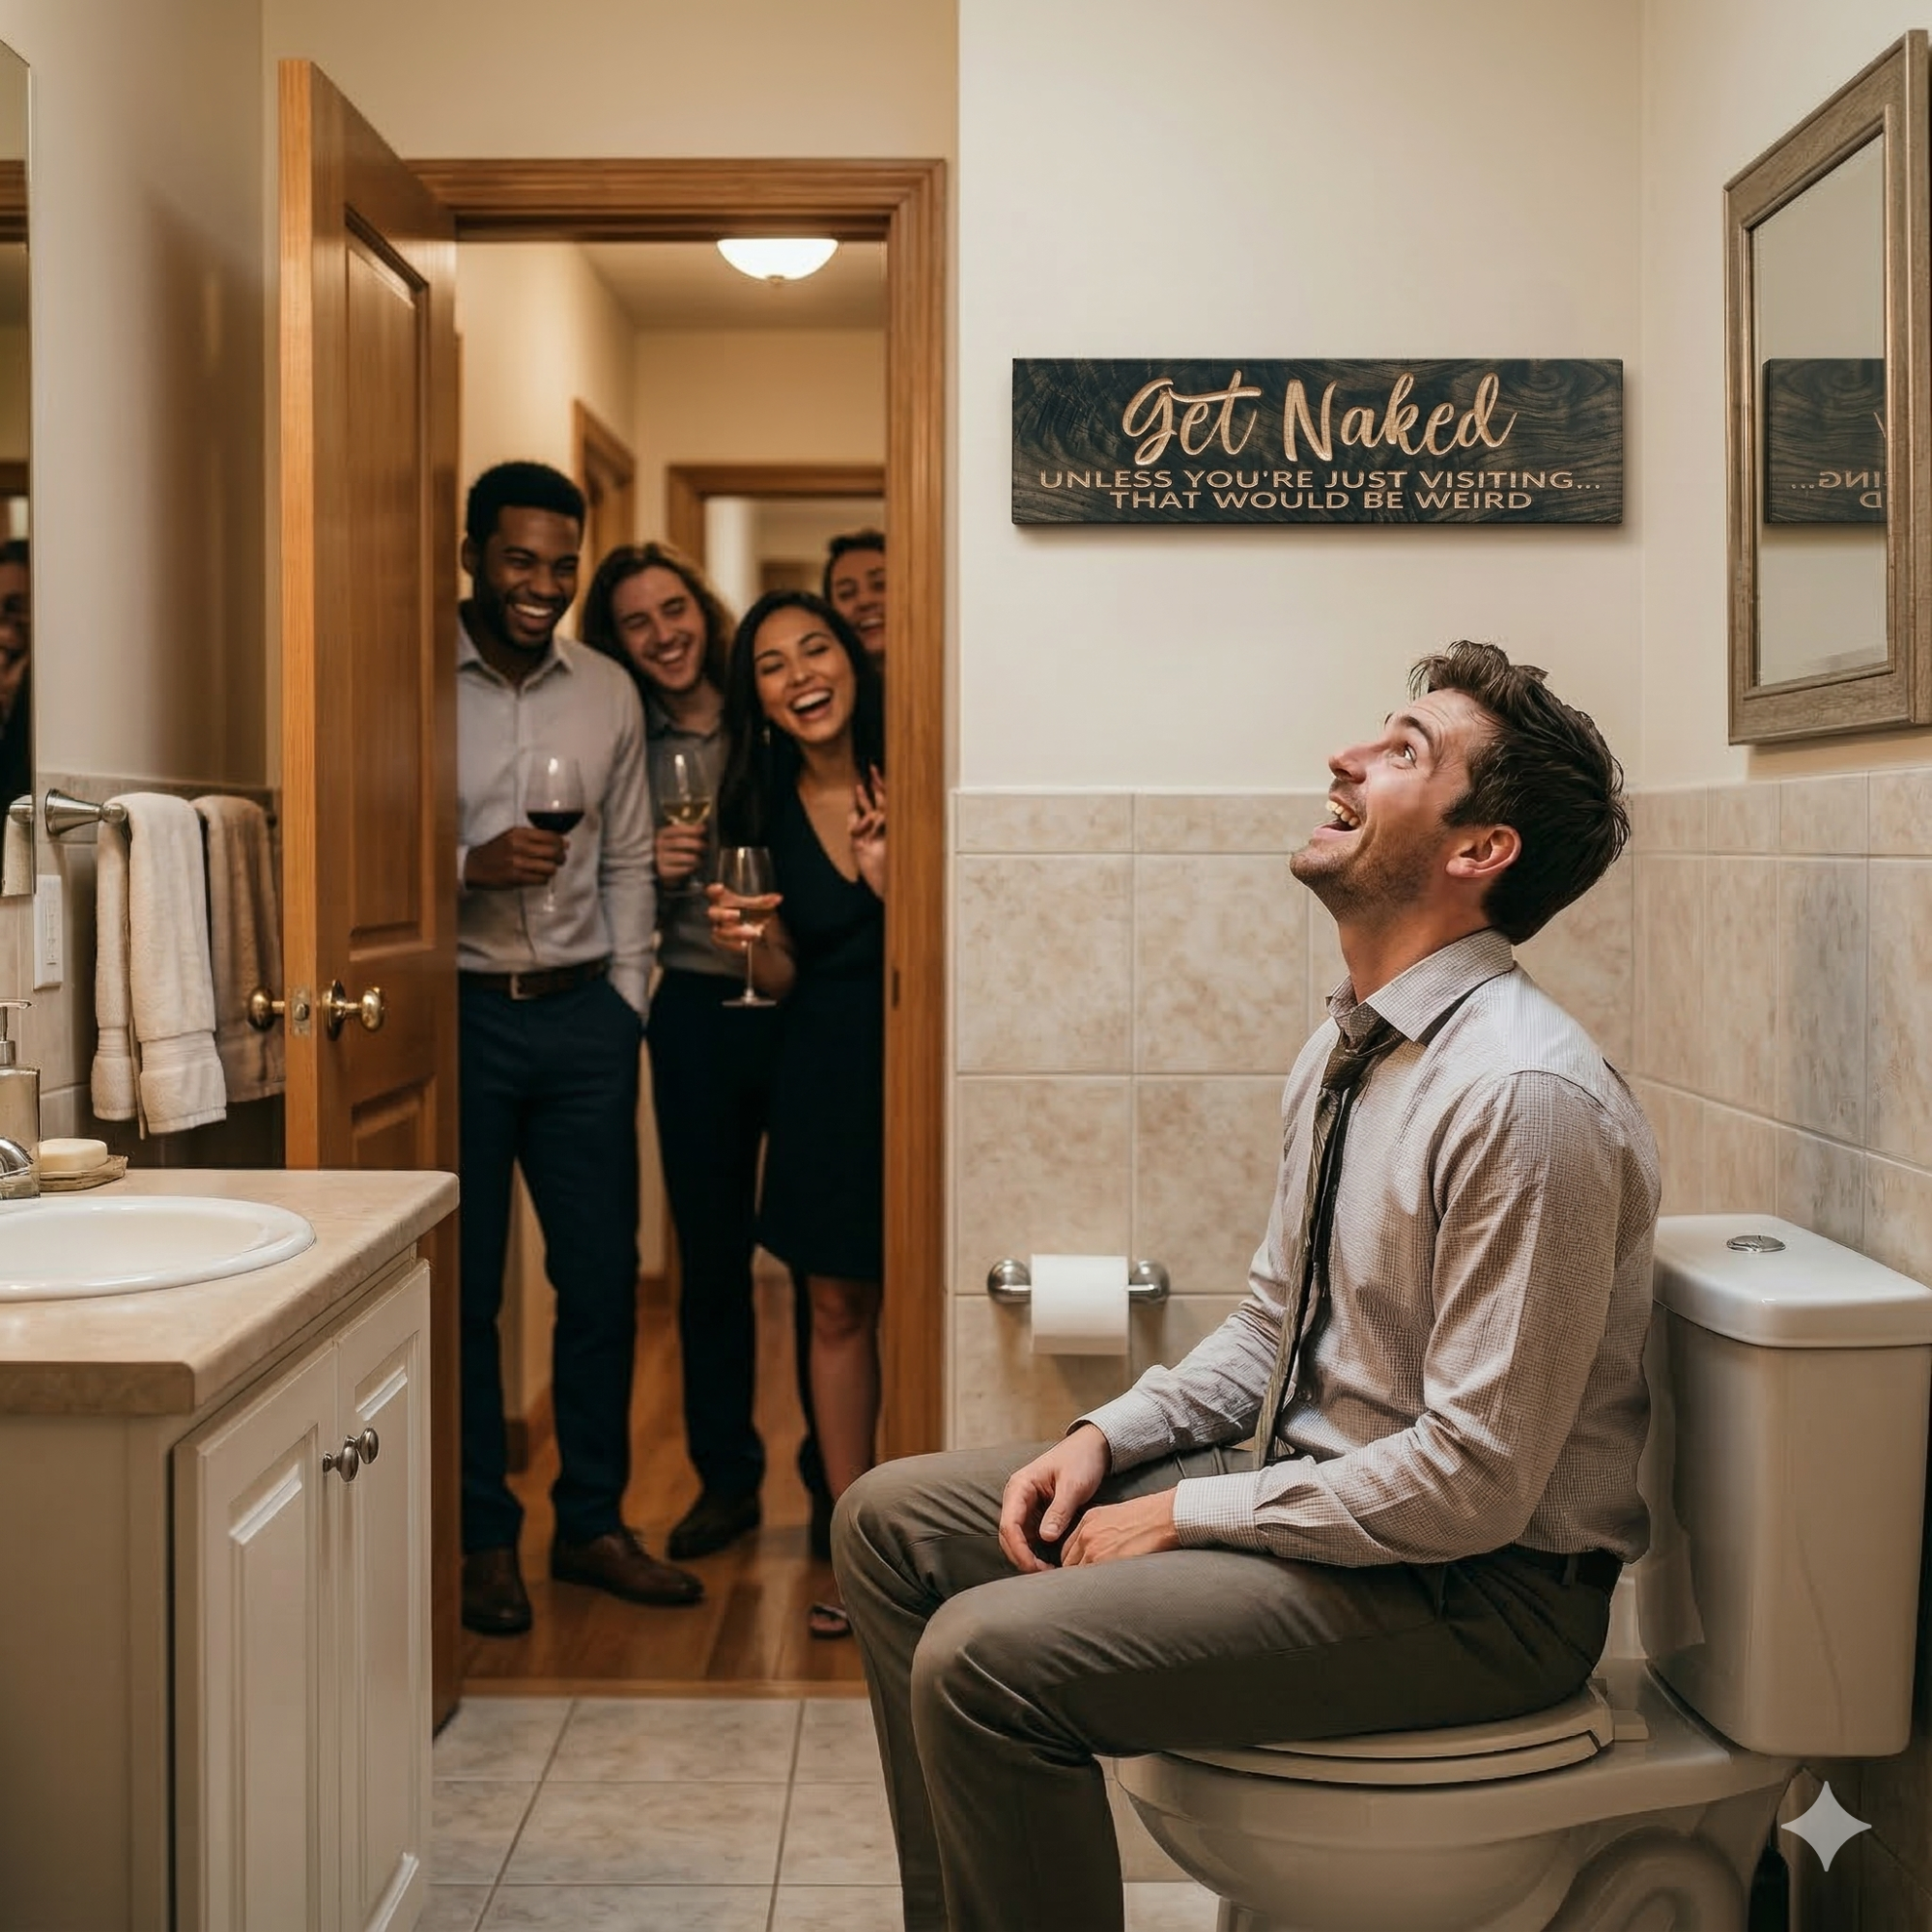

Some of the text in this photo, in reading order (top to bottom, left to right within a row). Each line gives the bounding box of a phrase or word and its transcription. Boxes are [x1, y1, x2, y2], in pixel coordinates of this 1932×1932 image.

[1283, 372, 1518, 462] Naked
[1039, 469, 1601, 490] UNLESS YOU'RE JUST VISITING...
[1109, 491, 1532, 509] THAT WOULD BE WEIRD
